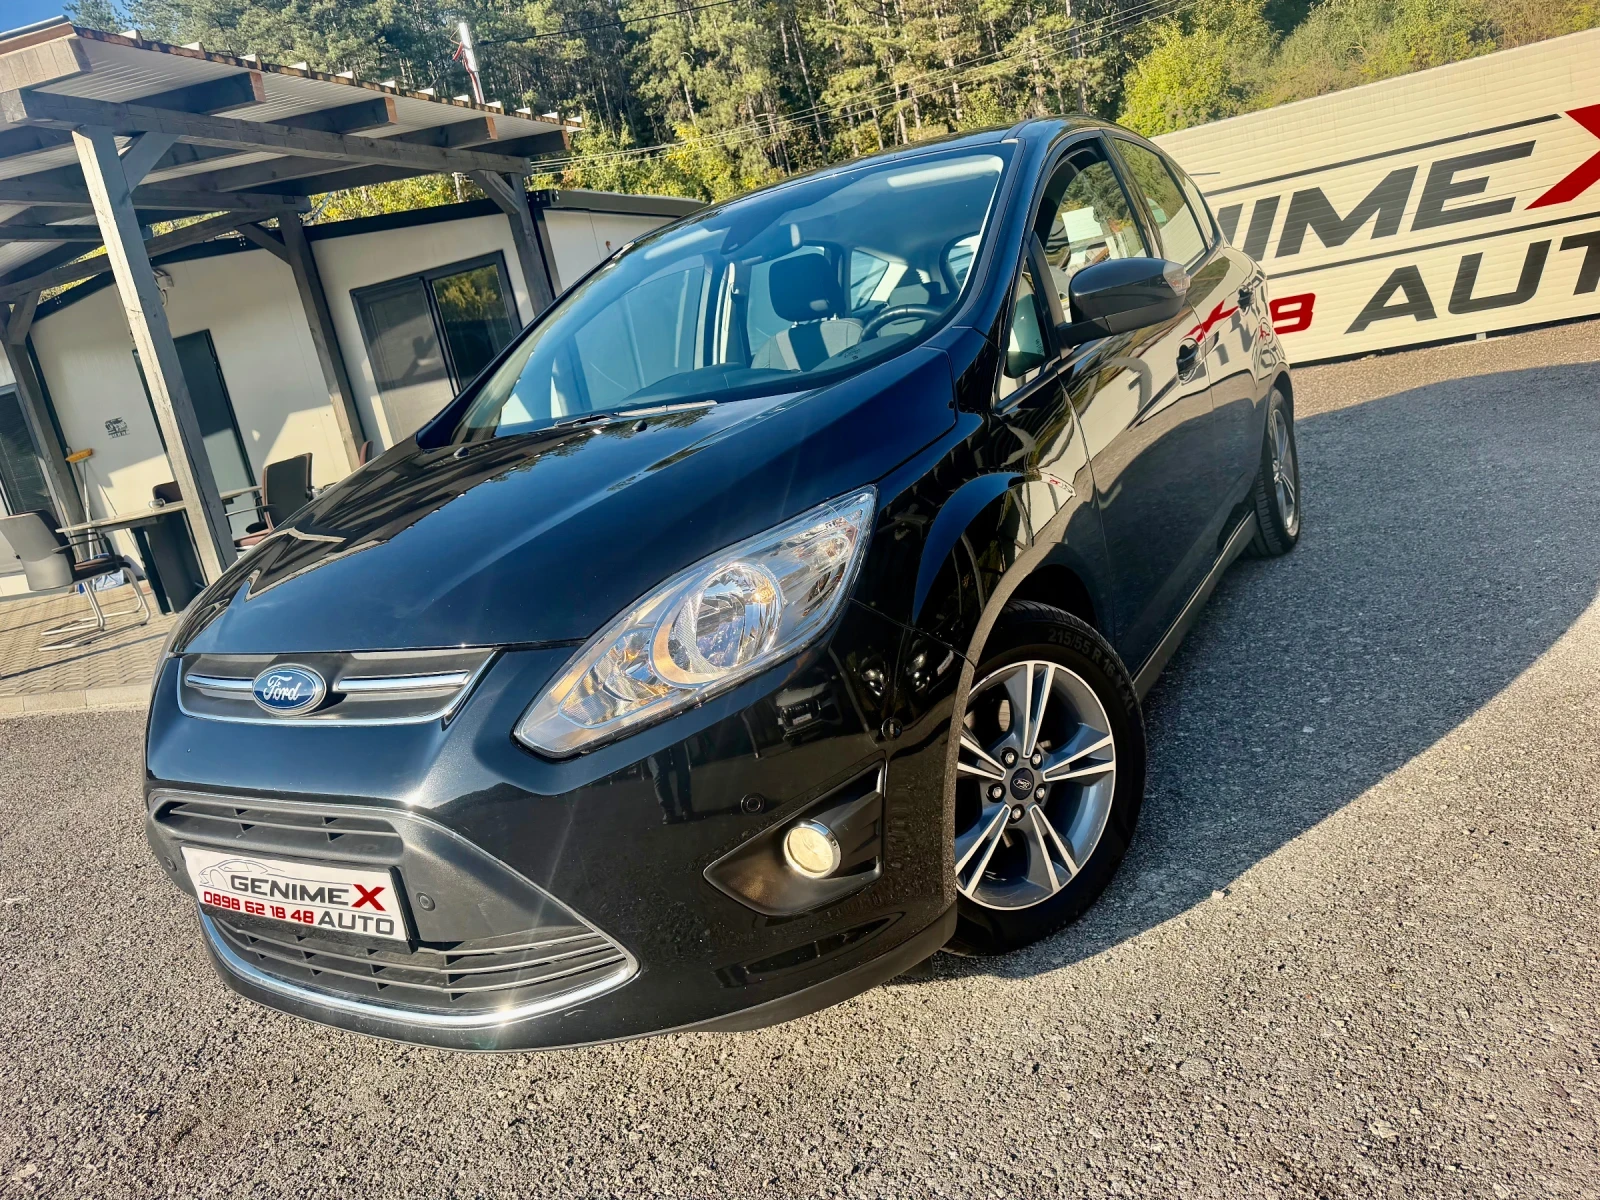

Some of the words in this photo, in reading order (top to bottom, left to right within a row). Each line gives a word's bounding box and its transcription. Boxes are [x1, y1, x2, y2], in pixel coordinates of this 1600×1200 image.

[1217, 103, 1600, 262] IME
[1048, 627, 1091, 655] 215/55
[1092, 649, 1102, 664] R
[1102, 658, 1116, 678] 16
[263, 675, 302, 701] Ford
[203, 890, 241, 911] 0898
[244, 900, 266, 916] 62
[269, 905, 287, 920] 18
[290, 909, 314, 925] 48
[230, 875, 386, 911] GENIMEX
[317, 910, 395, 936] AUTO
